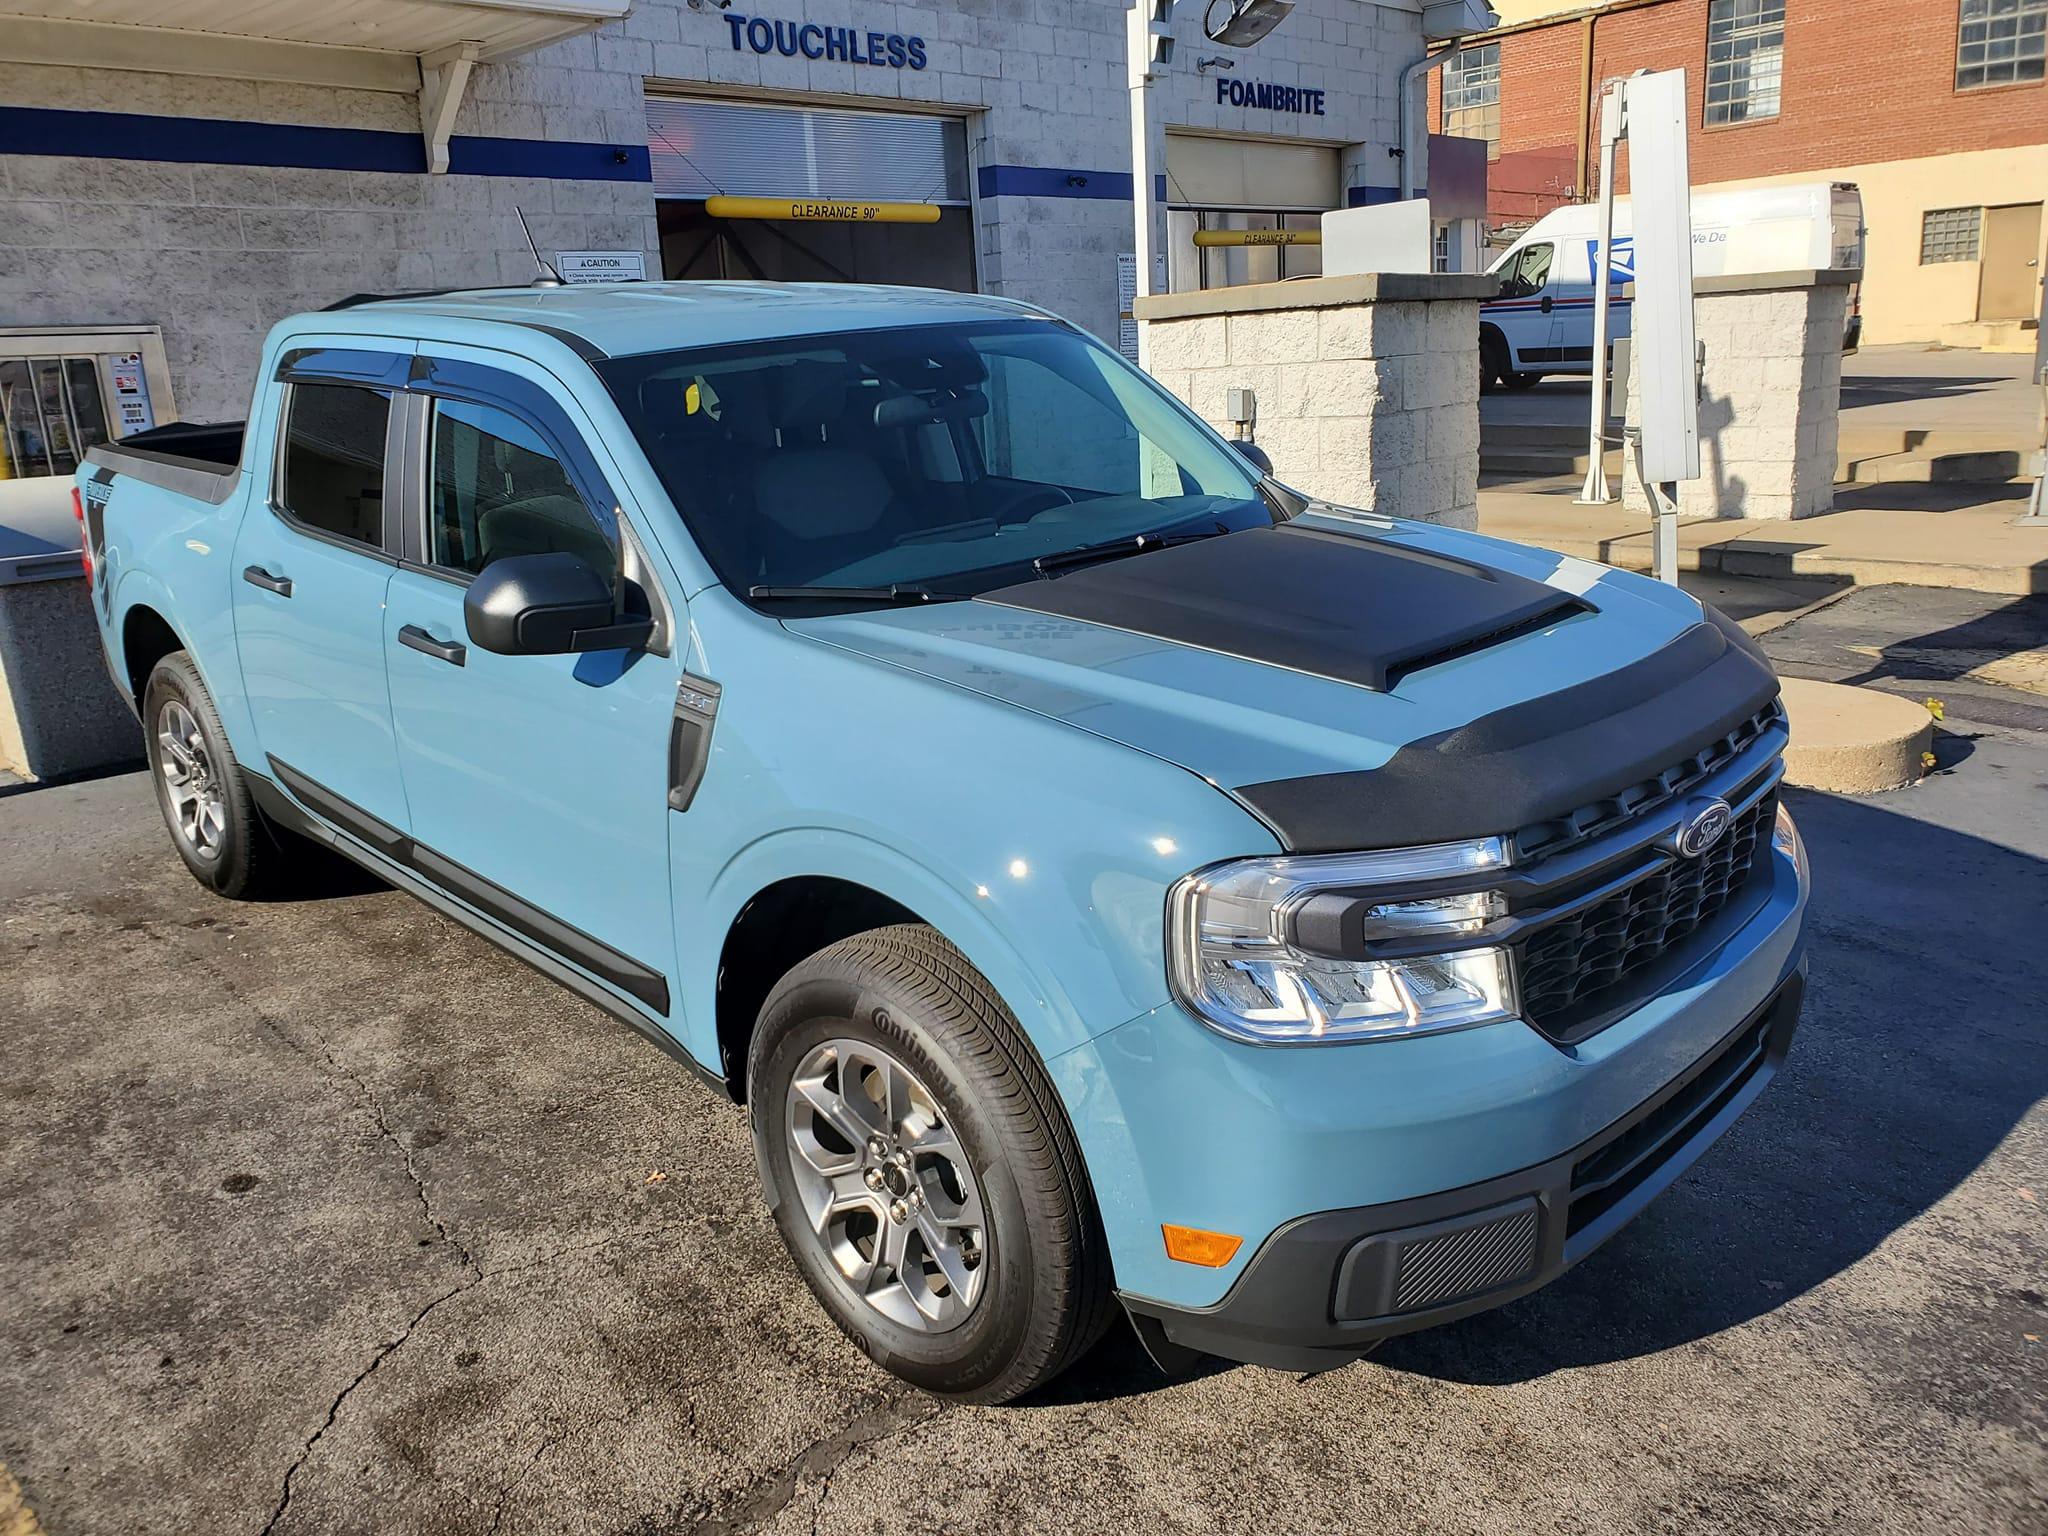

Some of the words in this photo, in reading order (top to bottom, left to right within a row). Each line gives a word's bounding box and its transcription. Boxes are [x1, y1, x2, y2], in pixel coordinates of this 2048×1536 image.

[724, 14, 927, 70] TOUCHLESS
[1217, 78, 1325, 116] FOAMBRITE
[791, 204, 858, 219] CLEARANCE
[863, 207, 880, 219] 90"
[1244, 233, 1284, 243] CLEARANCE
[586, 259, 621, 267] CAUTION
